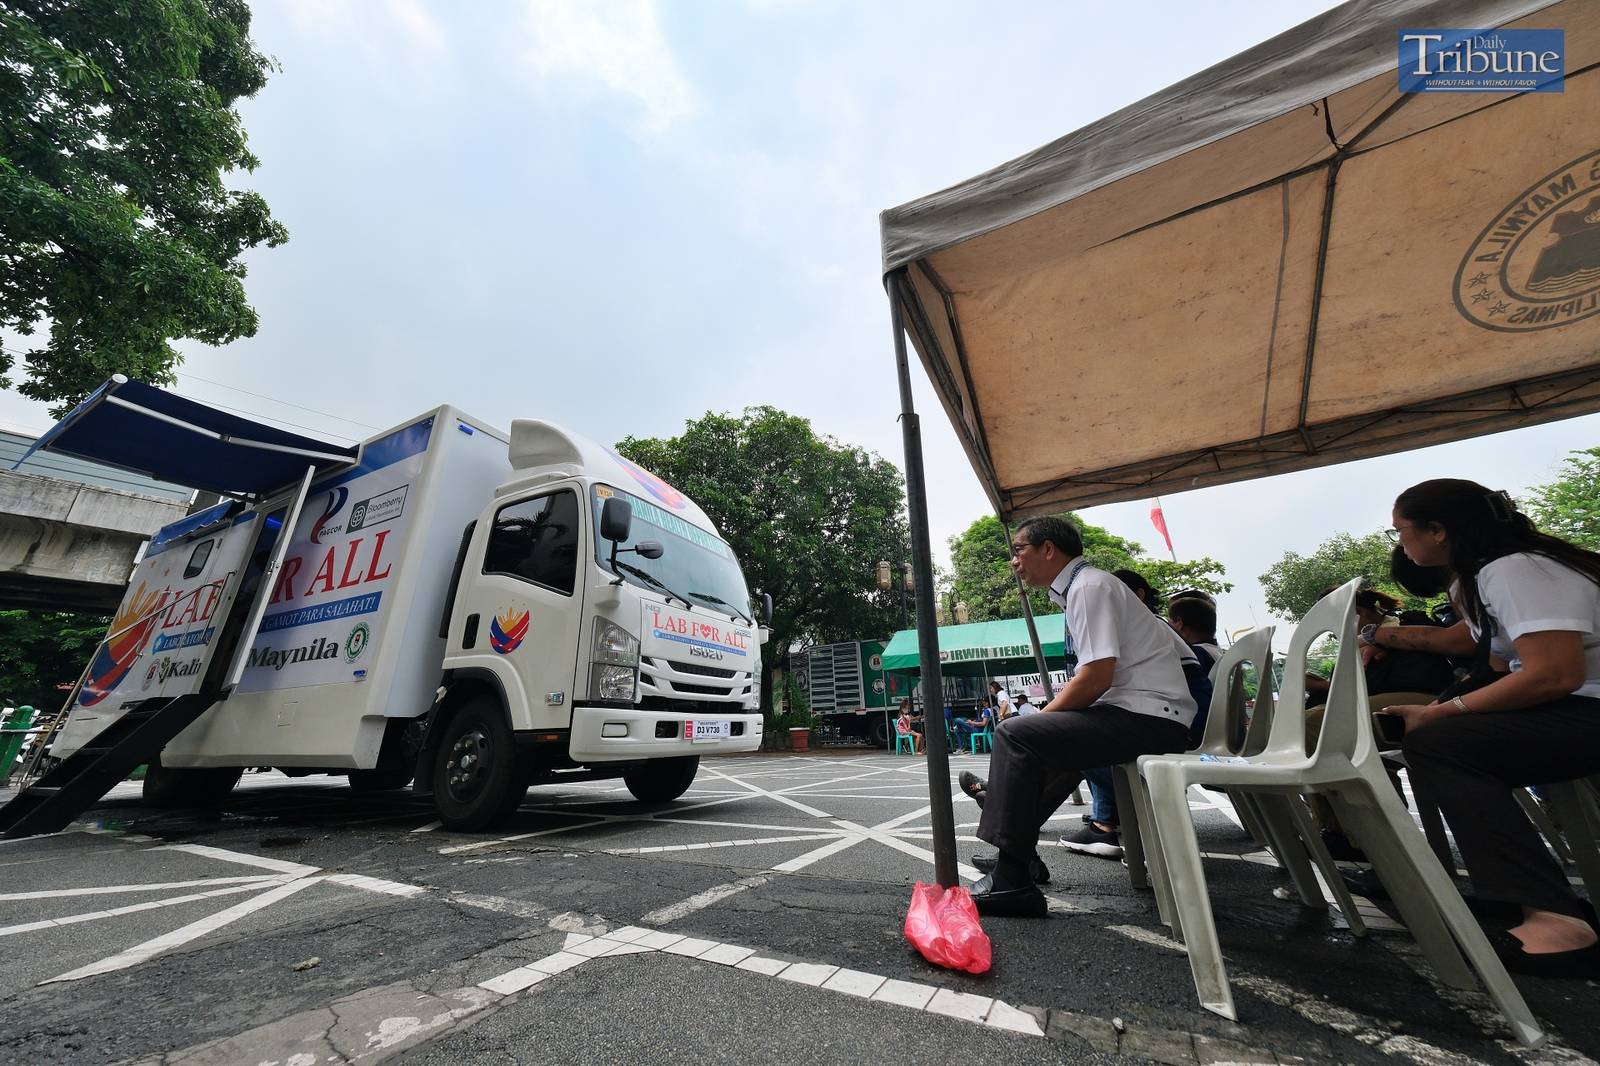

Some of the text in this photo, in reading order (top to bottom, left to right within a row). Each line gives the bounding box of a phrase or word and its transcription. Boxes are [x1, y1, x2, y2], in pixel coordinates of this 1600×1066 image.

[319, 525, 342, 537] PAGCOR
[304, 529, 392, 597] ALL
[299, 608, 323, 624] PARA
[324, 597, 376, 618] SALAHAT!
[653, 612, 687, 634] LAB
[724, 631, 747, 649] ALL
[247, 637, 339, 670] Maynila
[689, 645, 723, 660] ISUZU
[950, 645, 1029, 661] IRWIN TIENG
[1021, 673, 1053, 686] IRW
